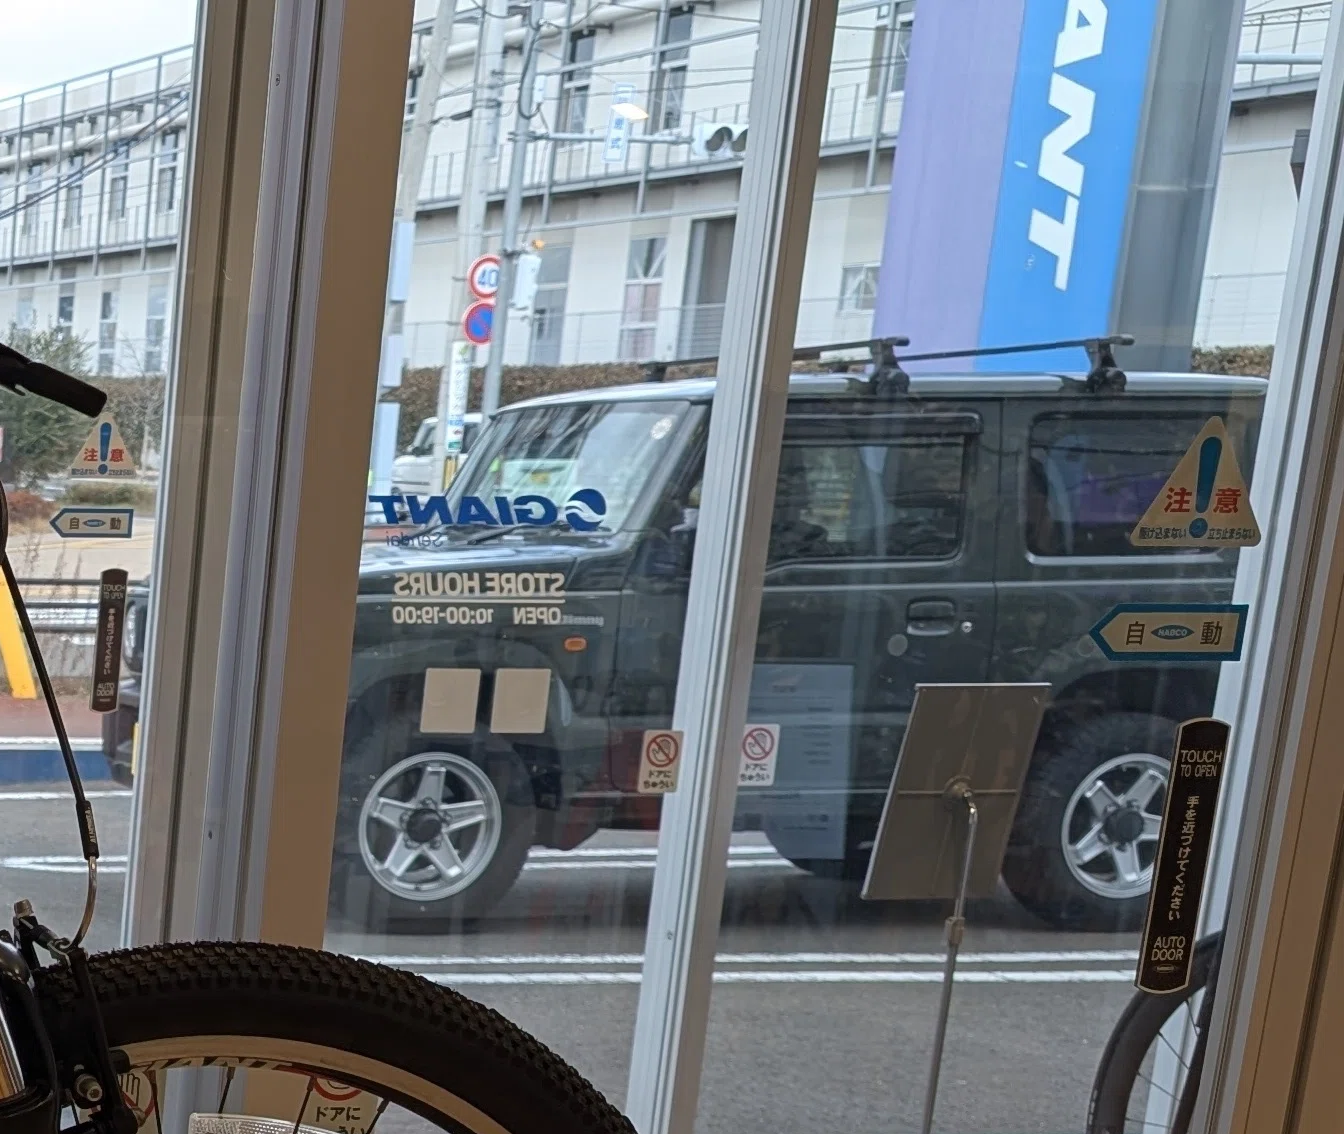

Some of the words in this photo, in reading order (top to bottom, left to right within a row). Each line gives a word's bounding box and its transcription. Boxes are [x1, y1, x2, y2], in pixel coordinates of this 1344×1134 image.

[1180, 750, 1223, 763] TOUCH
[1180, 764, 1192, 778] TO
[1194, 764, 1218, 778] OPEN
[1168, 795, 1200, 921] 手を近づけてください
[1154, 936, 1186, 949] AUTO
[1151, 949, 1184, 961] DOOR
[315, 1106, 362, 1121] ドアに
